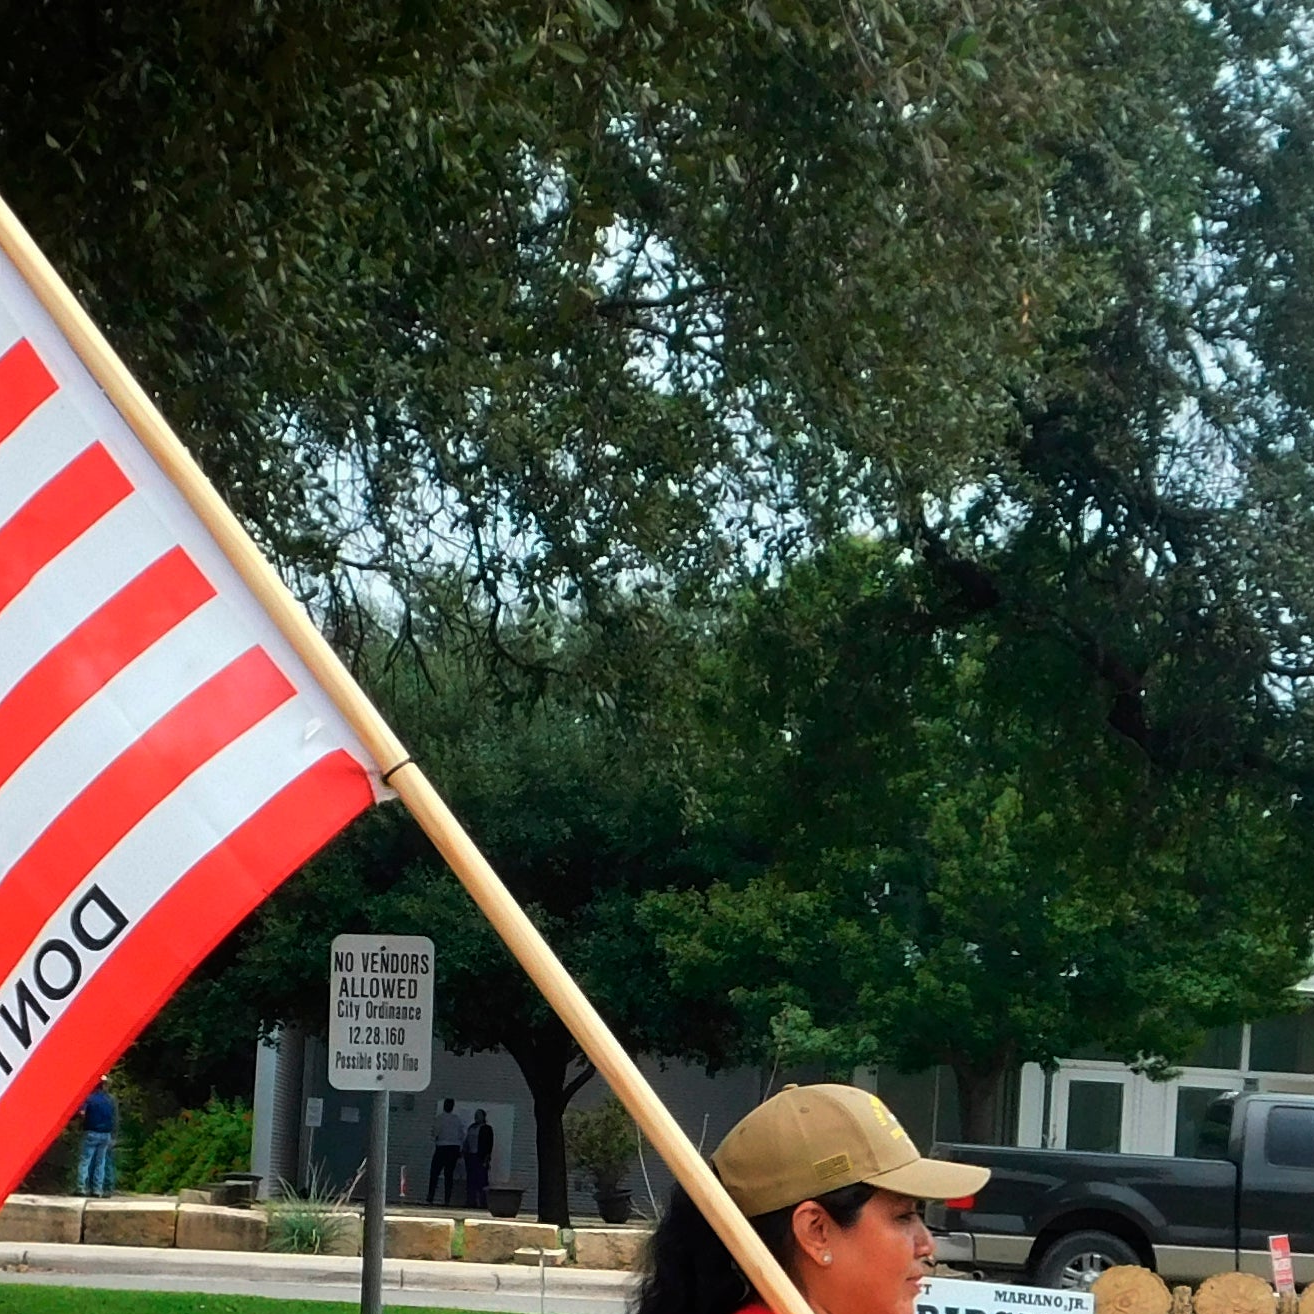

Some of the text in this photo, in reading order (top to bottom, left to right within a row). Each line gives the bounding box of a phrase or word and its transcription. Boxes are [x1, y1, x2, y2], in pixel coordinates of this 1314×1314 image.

[335, 951, 429, 975] NO VENDORS
[339, 976, 418, 999] ALLOWED
[337, 999, 422, 1021] City Ordinance
[348, 1026, 405, 1046] 12.28.160
[336, 1051, 419, 1072] Possible $500 fine
